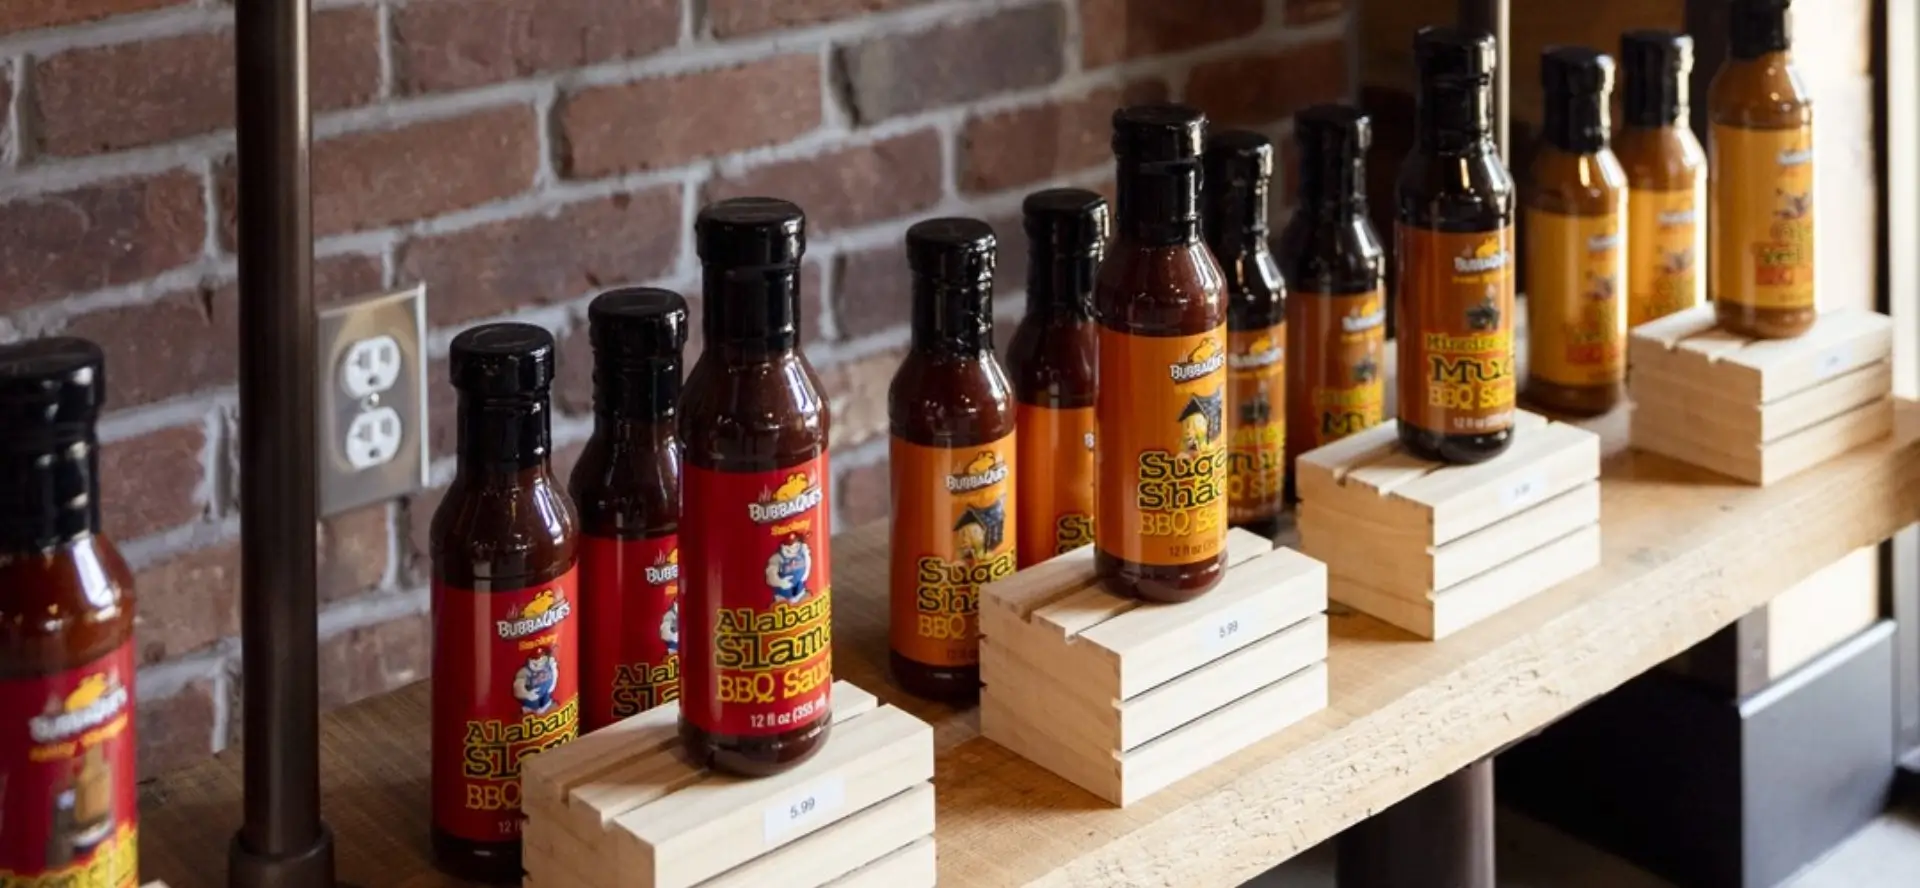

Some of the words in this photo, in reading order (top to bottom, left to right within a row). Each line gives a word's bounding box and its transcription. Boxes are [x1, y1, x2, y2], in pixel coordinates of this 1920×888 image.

[1138, 509, 1191, 537] BBQ
[918, 614, 967, 640] BBQ
[1219, 620, 1238, 639] 5.99
[717, 672, 776, 704] BBQ
[750, 713, 764, 728] 12
[466, 780, 522, 812] BBQ
[790, 797, 816, 819] 5.99
